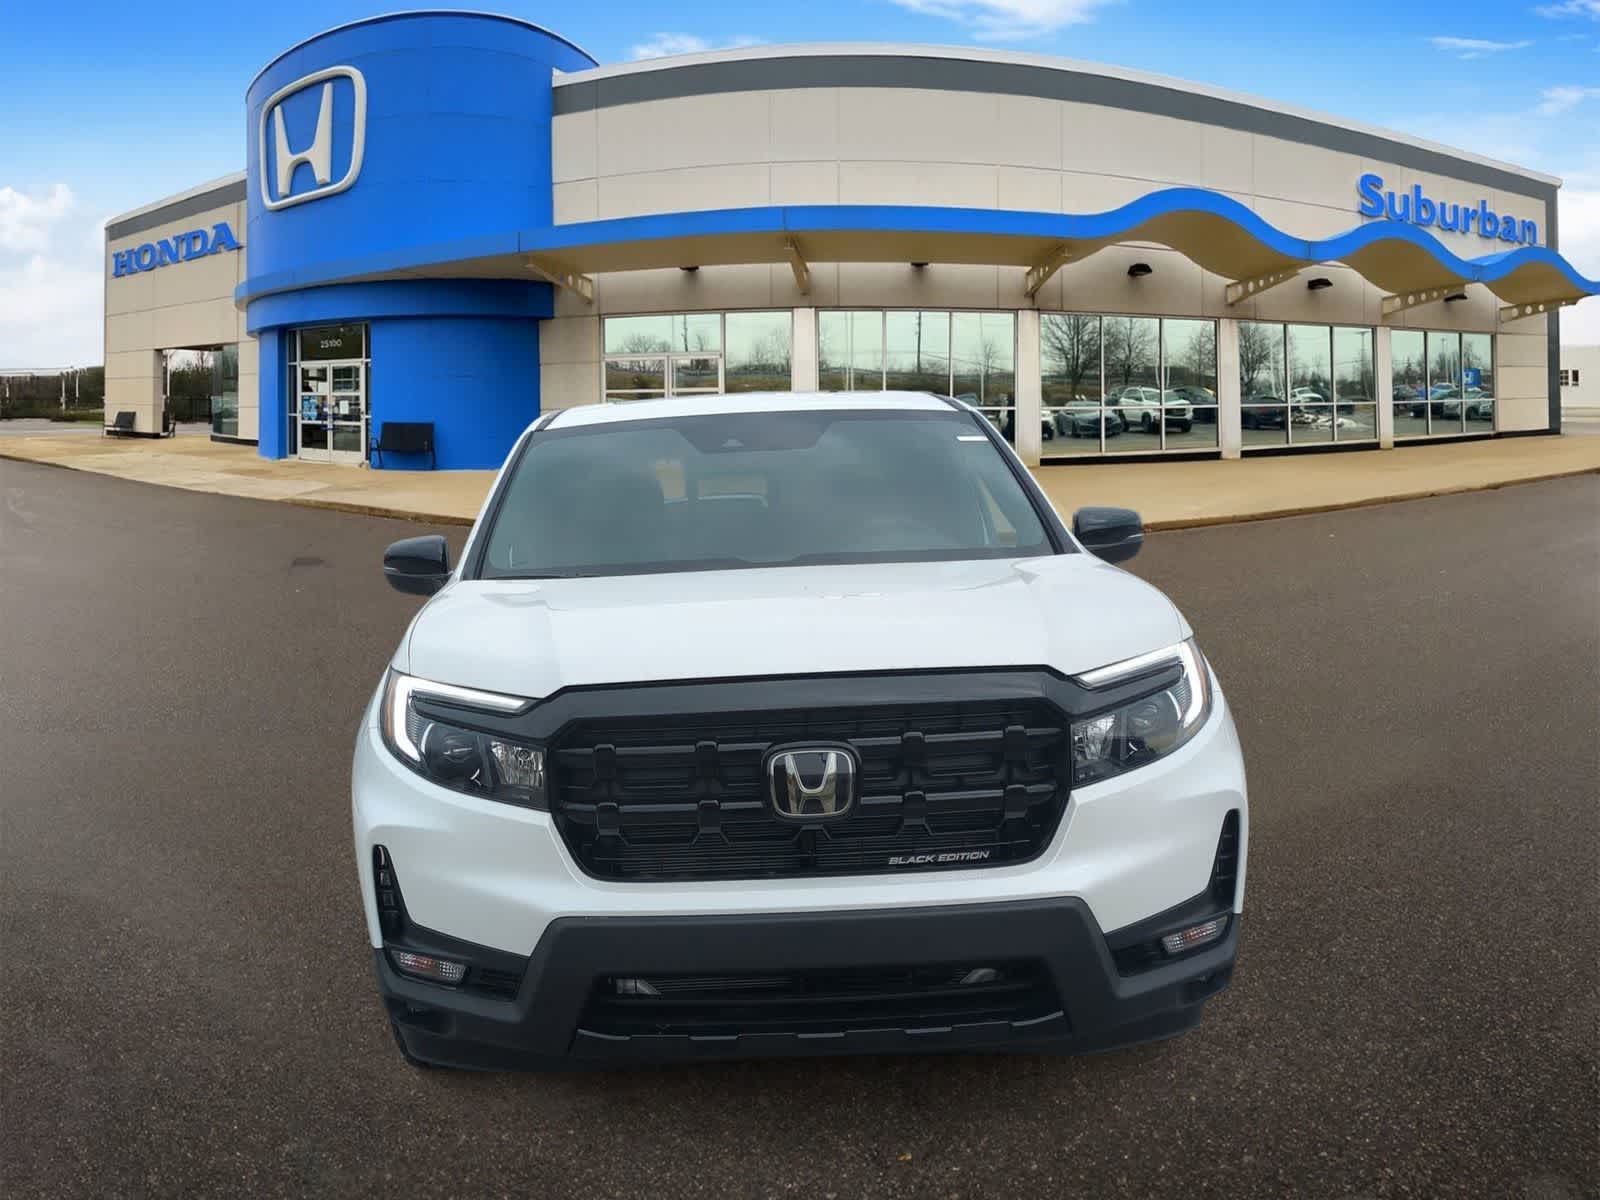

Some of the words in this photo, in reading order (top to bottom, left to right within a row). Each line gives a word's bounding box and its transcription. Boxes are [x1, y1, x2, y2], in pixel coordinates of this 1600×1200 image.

[1358, 173, 1537, 245] Suburban
[112, 221, 241, 278] HONDA
[888, 855, 936, 865] BLACK
[937, 850, 990, 862] EDITION
